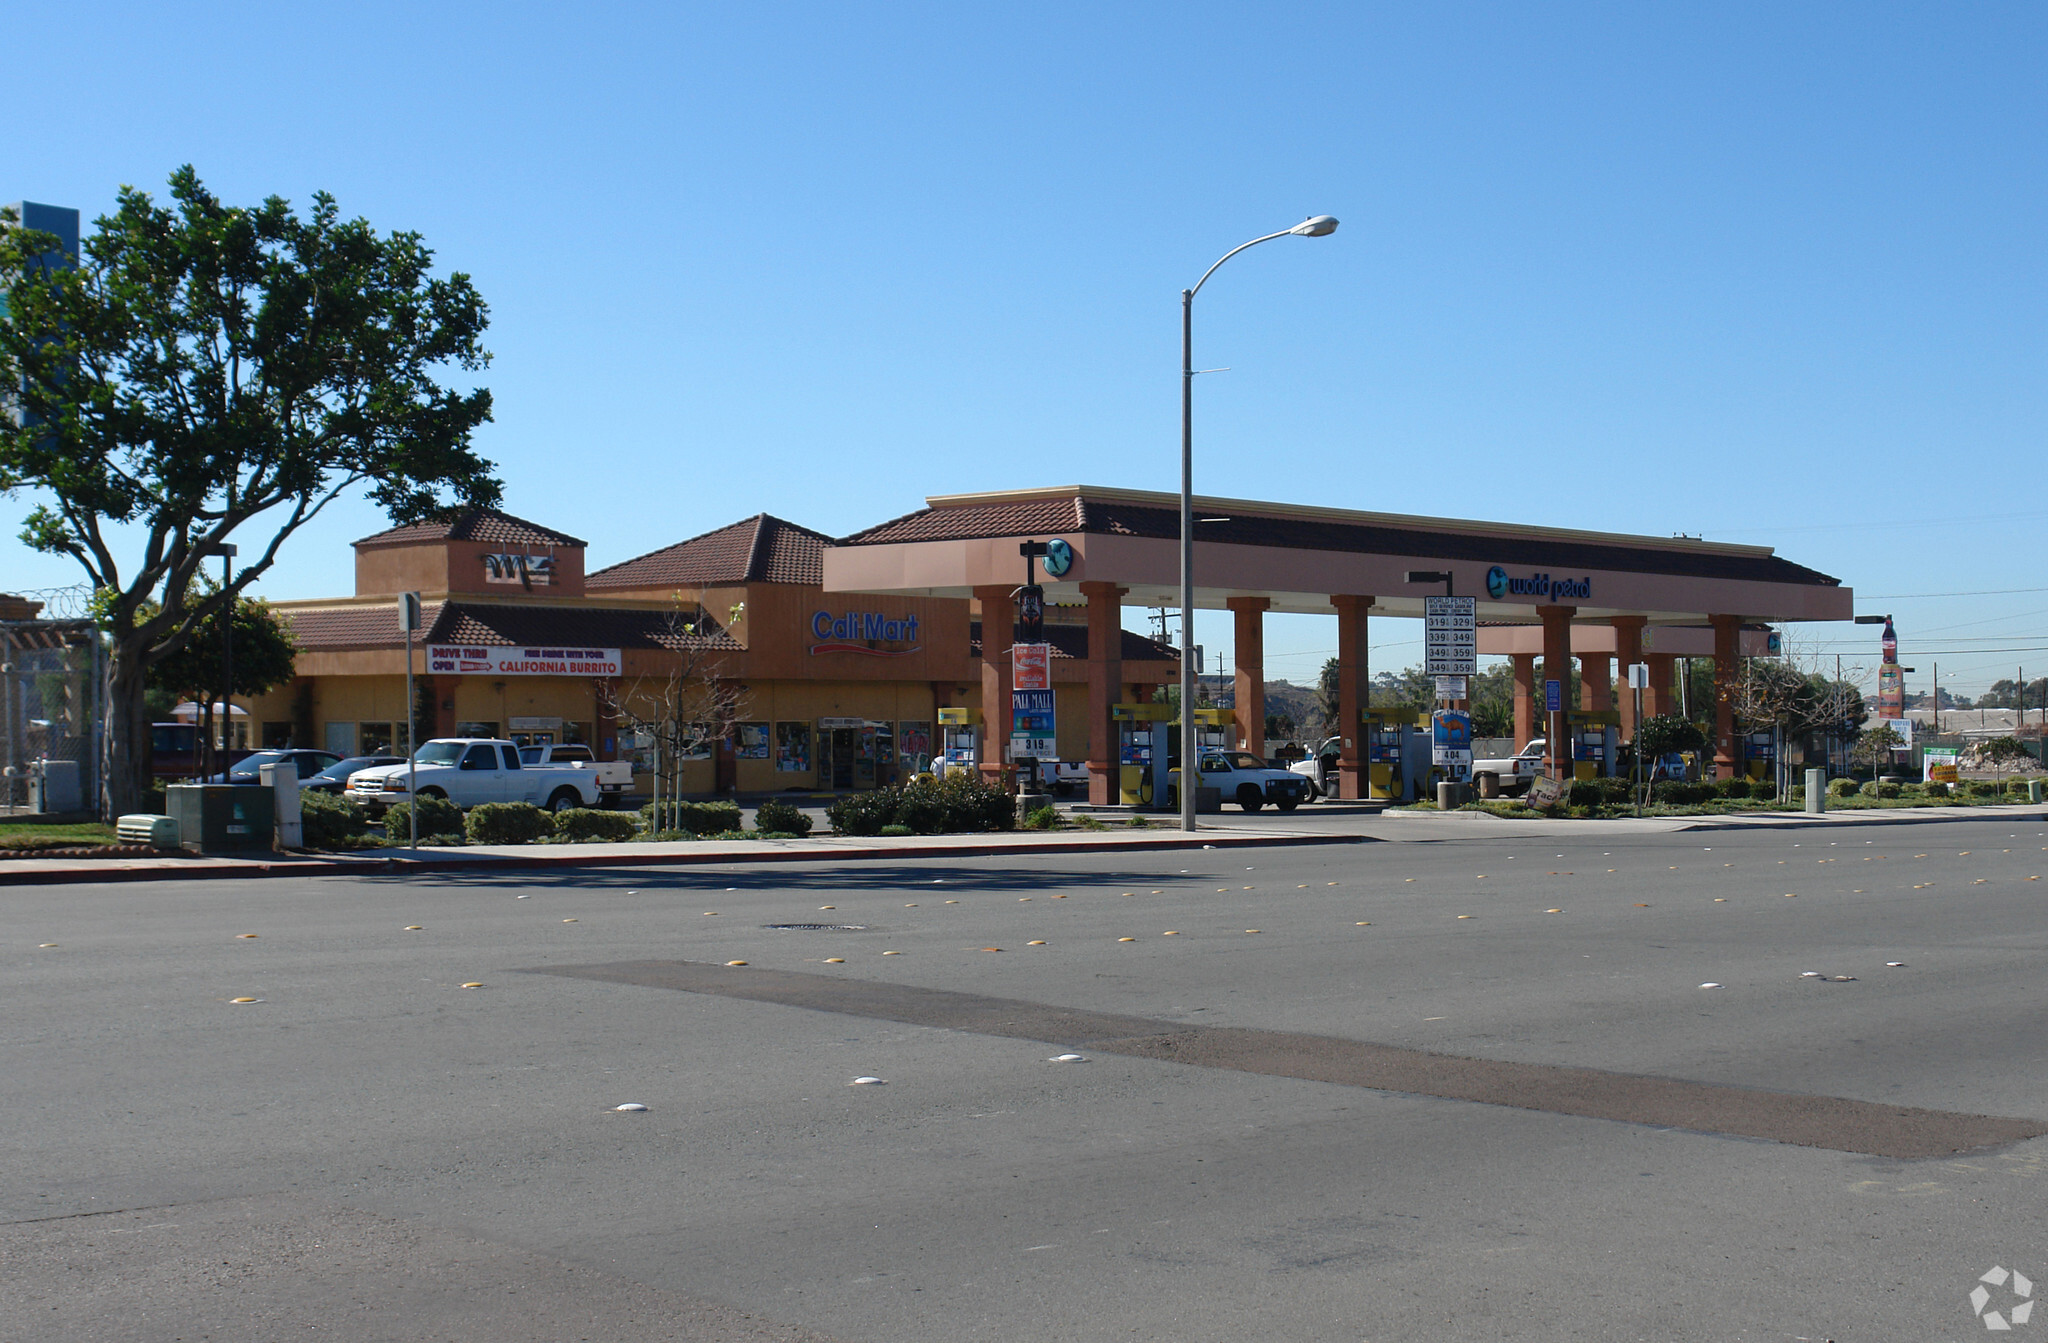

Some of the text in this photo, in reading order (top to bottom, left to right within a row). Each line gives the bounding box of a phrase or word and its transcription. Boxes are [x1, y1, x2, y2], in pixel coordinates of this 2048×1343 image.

[1509, 573, 1591, 602] world petrol
[432, 648, 488, 659] DRIVE THRU
[585, 651, 605, 659] YOUR
[432, 661, 455, 670] OPEN
[499, 661, 566, 673] CALIFORNIA
[570, 662, 617, 673] BURRITO
[1012, 693, 1052, 709] PALL MALL
[1433, 708, 1470, 719] CAMEL
[1026, 738, 1044, 750] 319
[1444, 750, 1460, 759] 404
